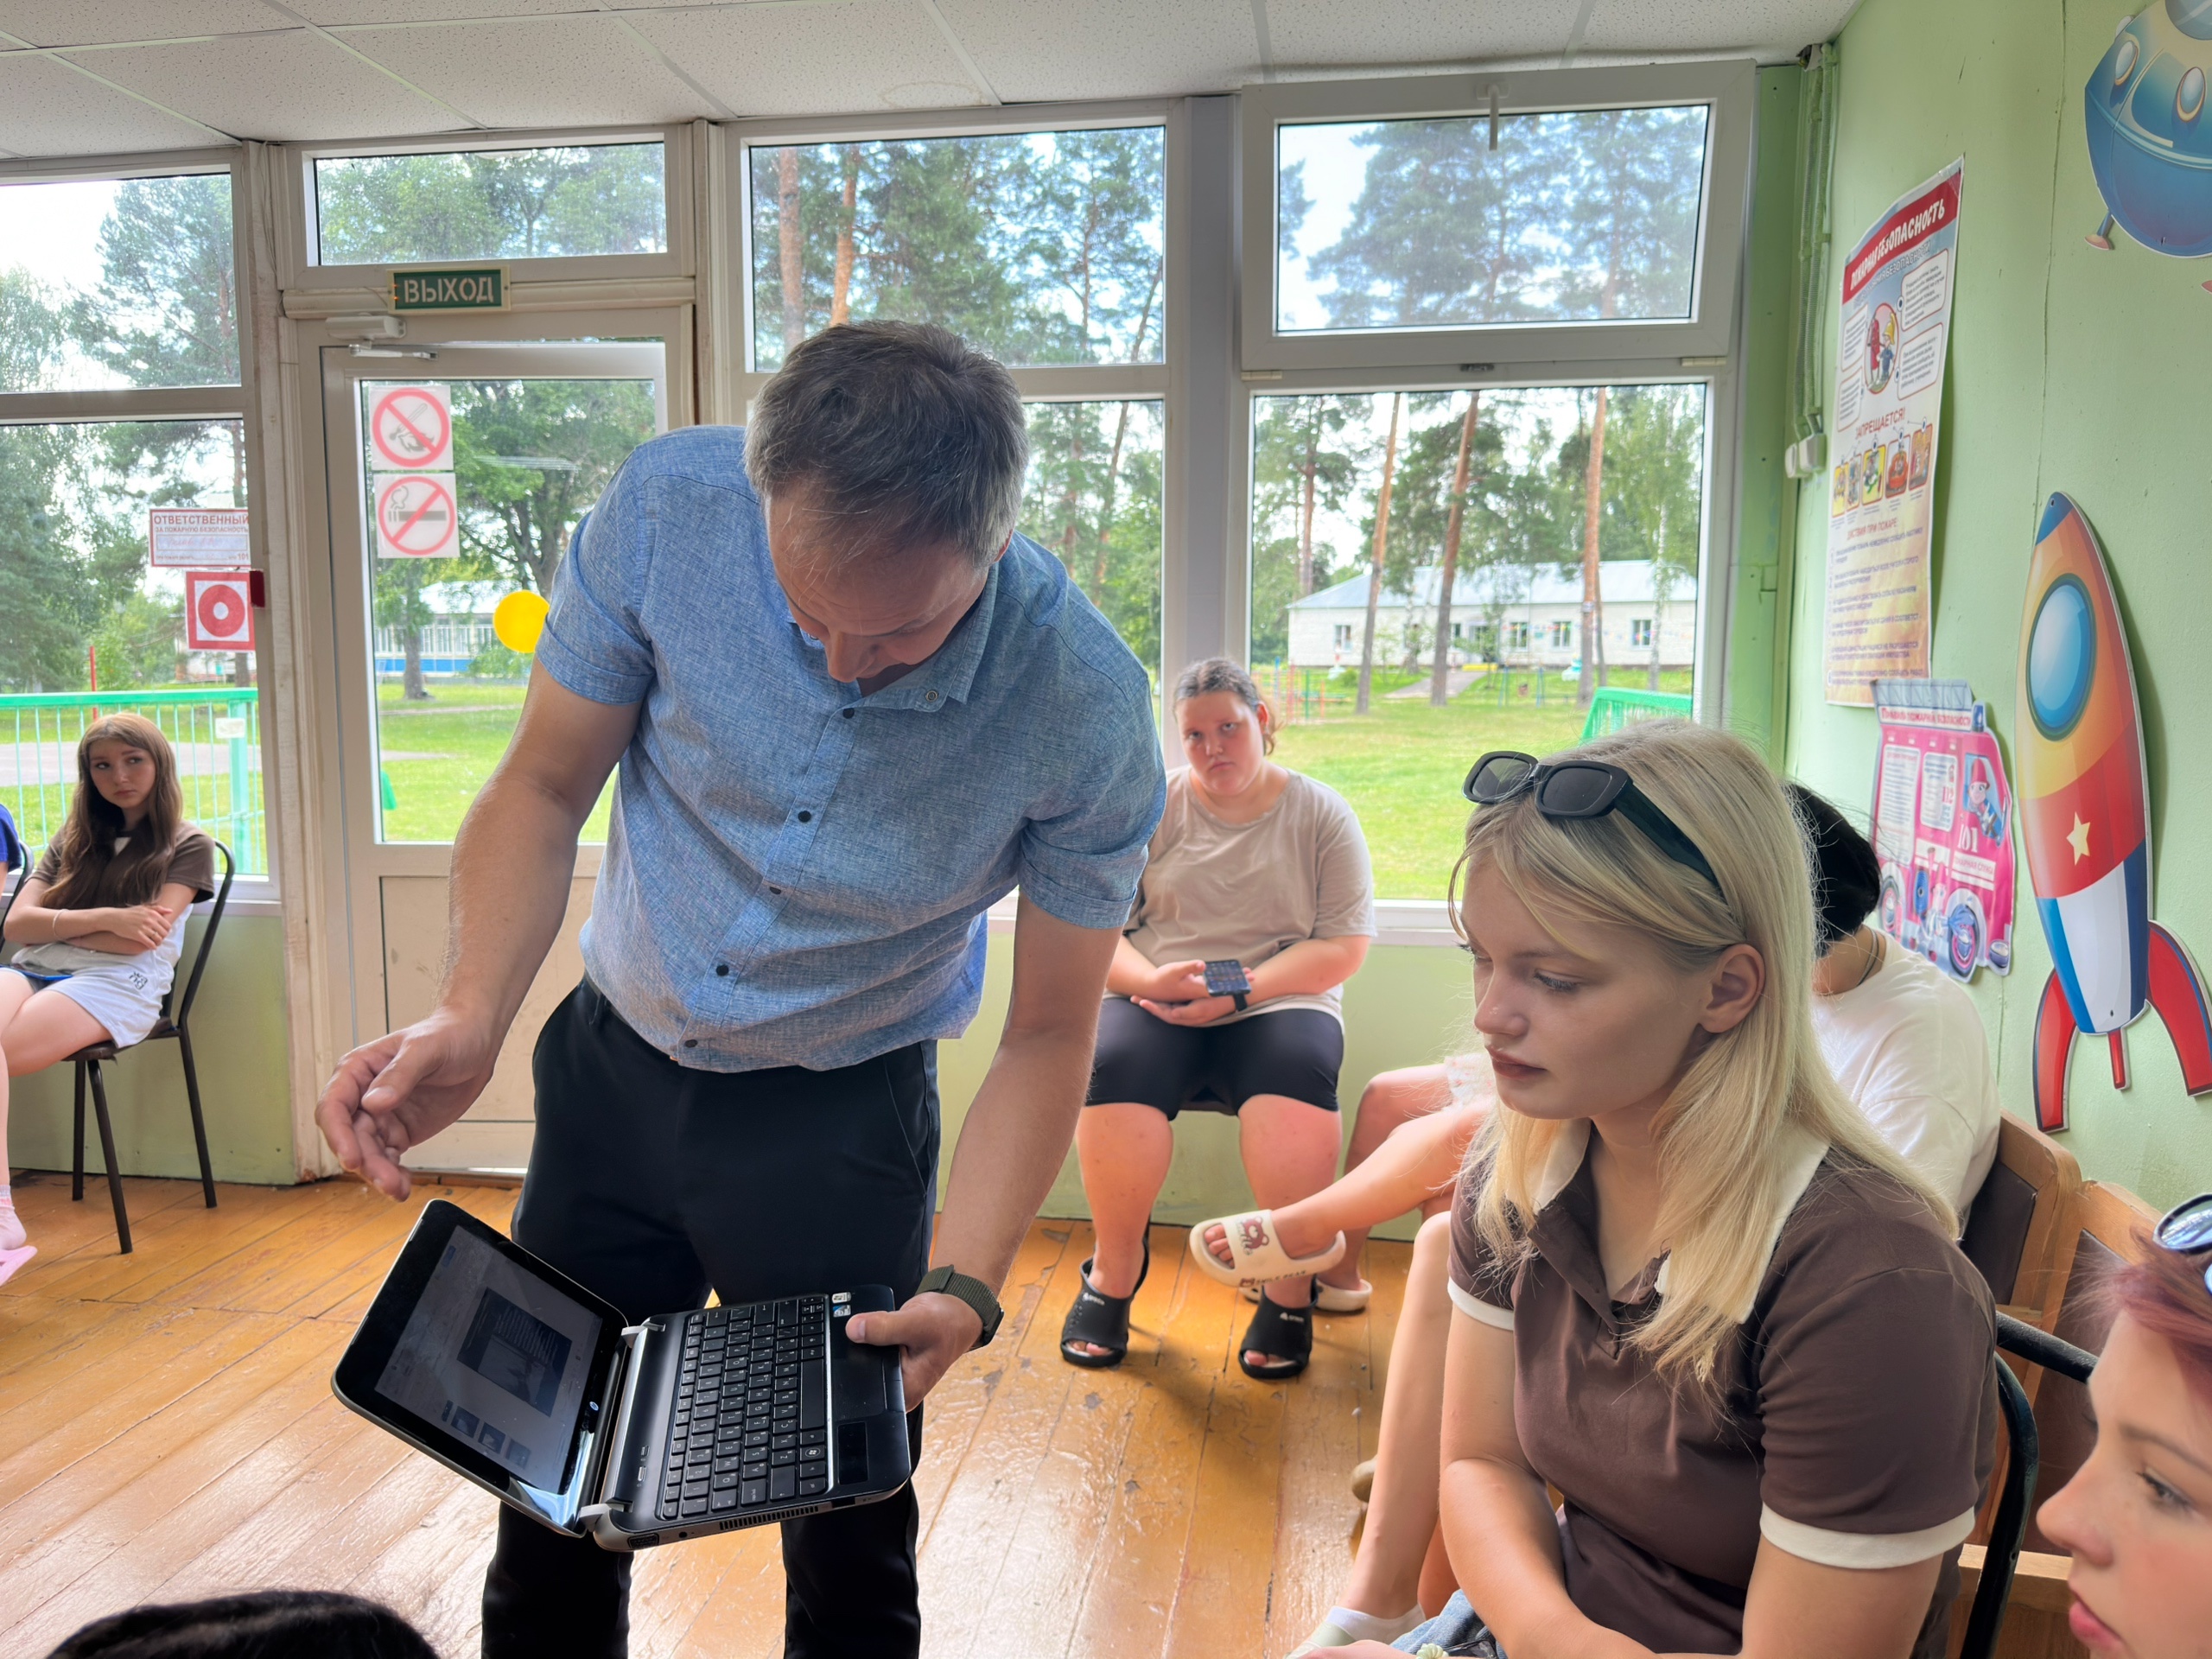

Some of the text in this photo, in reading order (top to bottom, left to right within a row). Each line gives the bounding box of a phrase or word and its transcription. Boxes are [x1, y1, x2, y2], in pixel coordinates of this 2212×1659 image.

[1878, 199, 1945, 261] БЕЗОПАСНОСТЬ
[404, 276, 494, 303] ВЫХОД
[154, 514, 249, 524] ОТВЕТСТВЕННЫЙ
[1958, 823, 1978, 853] 101
